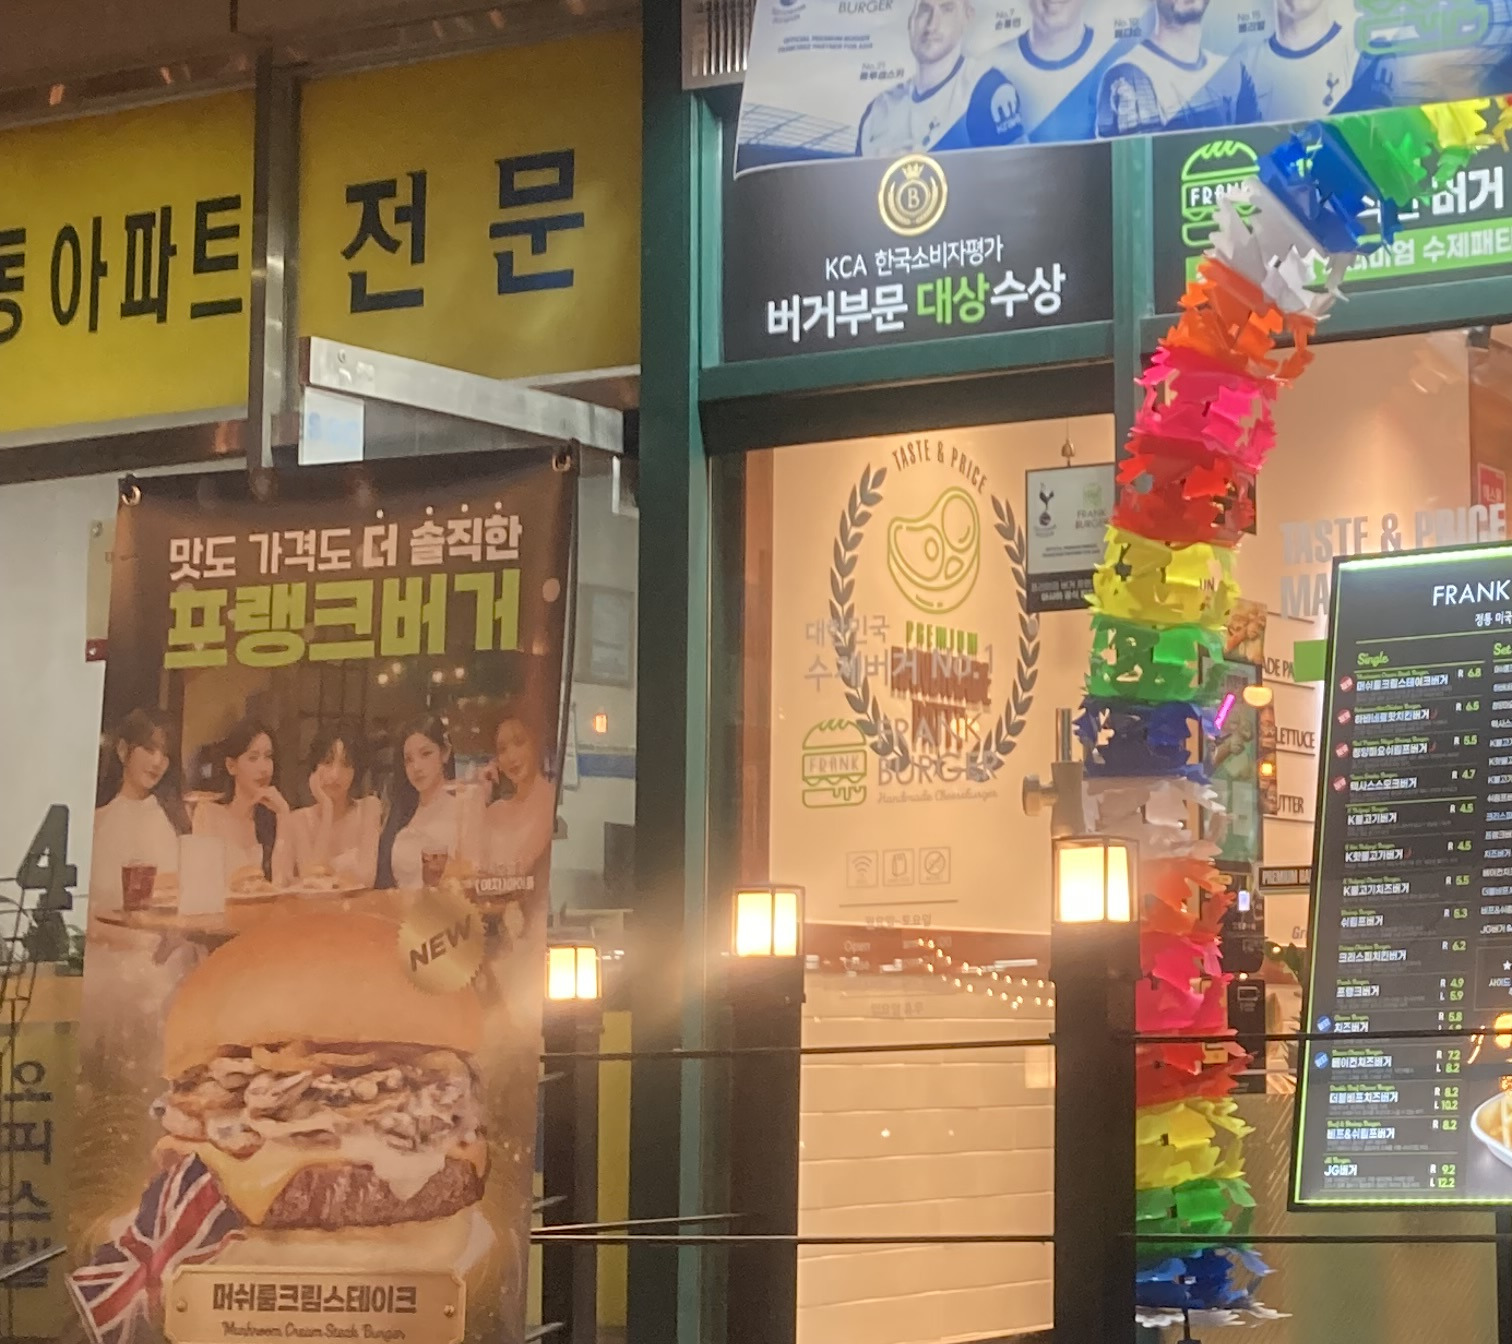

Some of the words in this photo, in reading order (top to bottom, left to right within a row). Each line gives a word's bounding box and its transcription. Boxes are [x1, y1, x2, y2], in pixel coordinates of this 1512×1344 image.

[825, 253, 867, 281] KCA
[875, 234, 1004, 278] 한국소비자평가
[767, 284, 909, 343] 버거부문
[892, 439, 931, 472] TASTE
[951, 446, 987, 494] PRICE
[169, 532, 236, 581] 맛도
[248, 526, 352, 574] 가격도
[361, 520, 399, 570] 더
[410, 512, 522, 566] 솔직한
[1432, 579, 1511, 606] FRANK
[162, 567, 521, 670] 프랭크버거
[1475, 612, 1493, 627] 정통
[1357, 651, 1389, 668] Single
[408, 914, 471, 972] NEW
[213, 1282, 417, 1314] 머쉬룸크림스테이크
